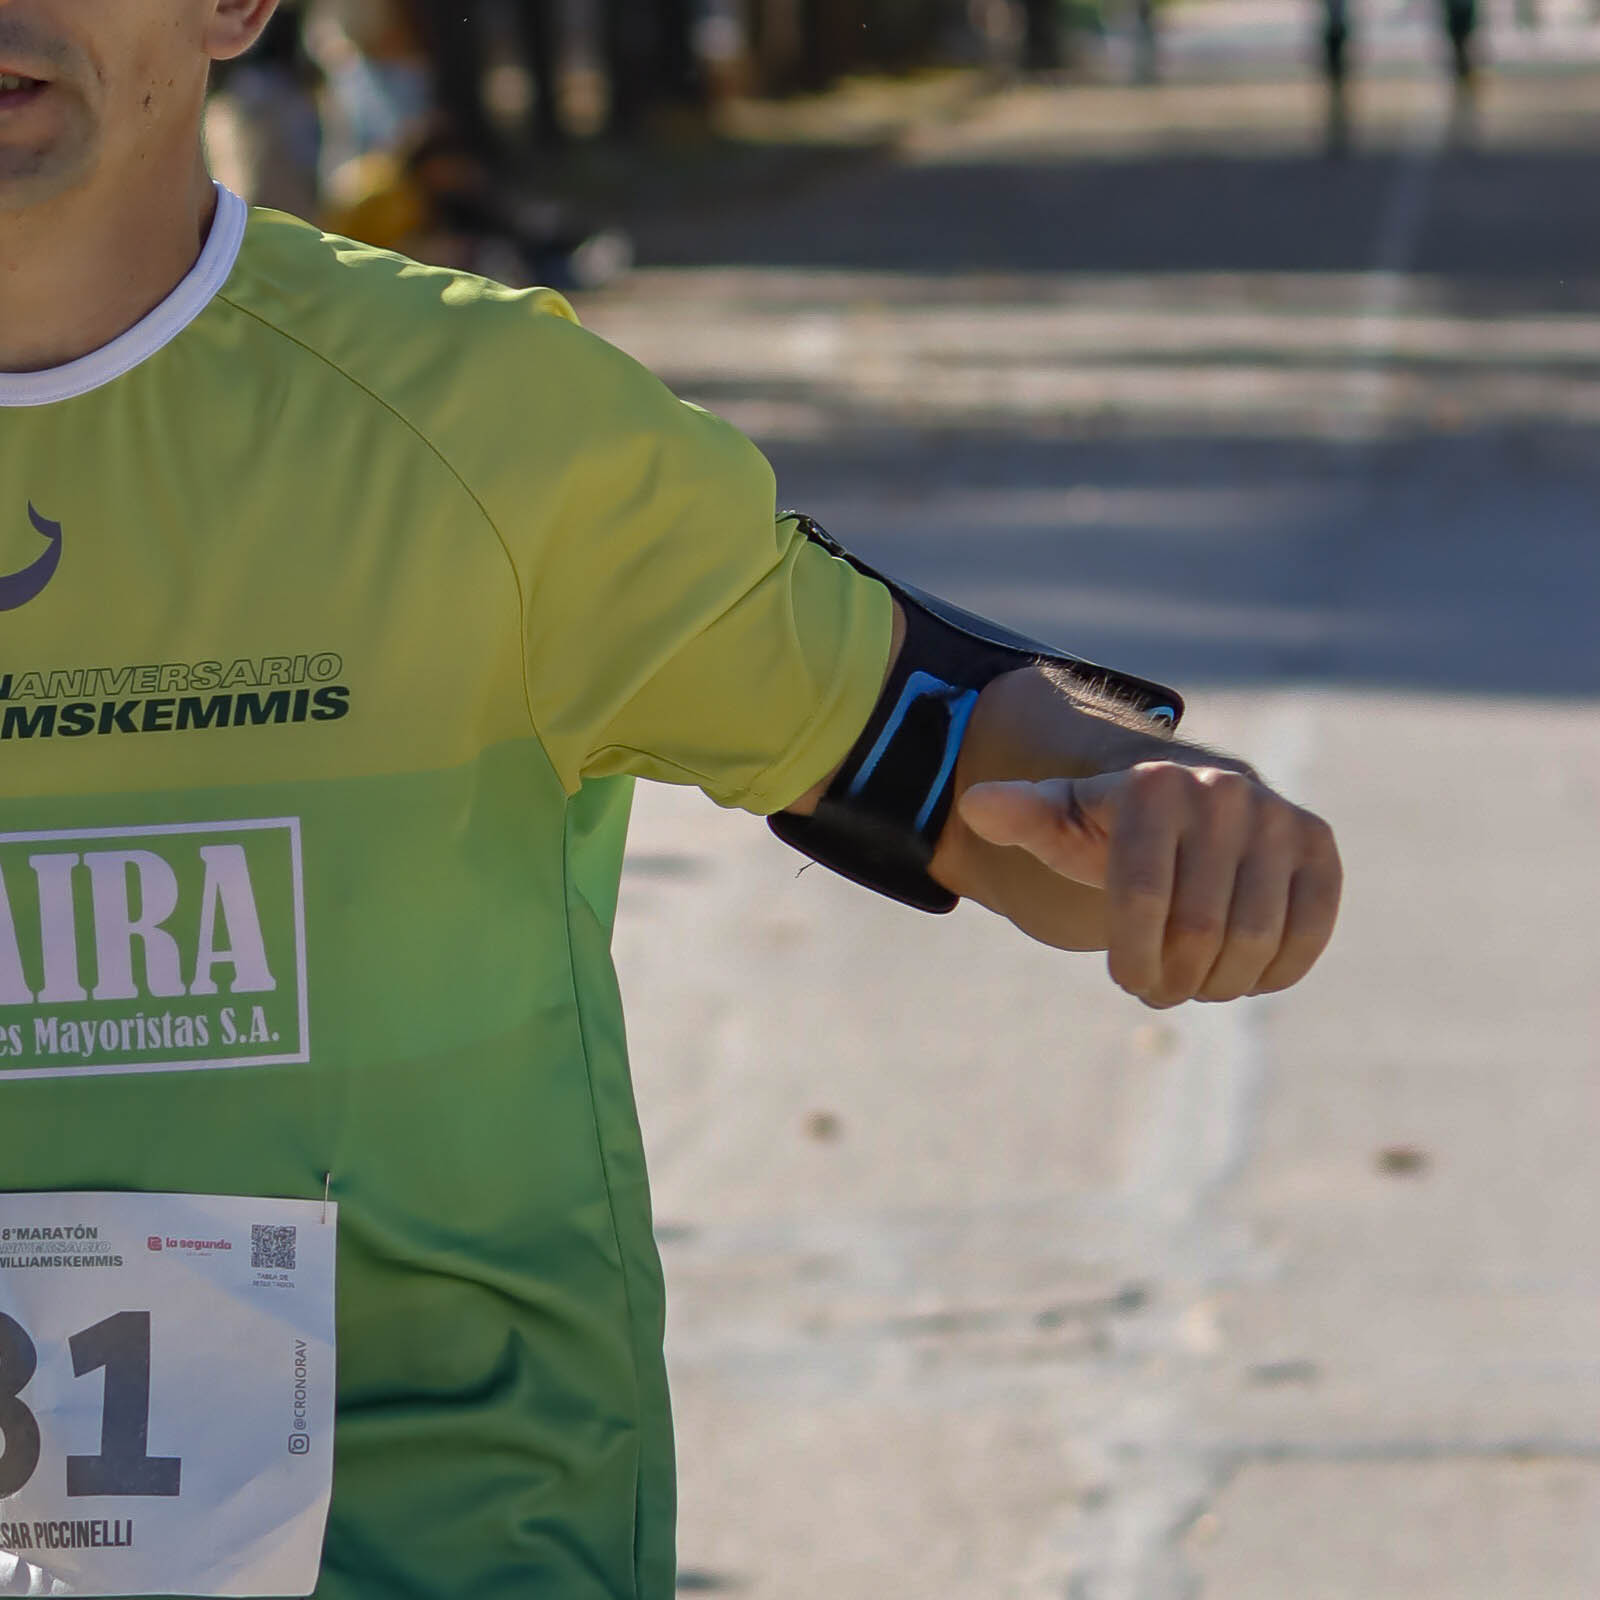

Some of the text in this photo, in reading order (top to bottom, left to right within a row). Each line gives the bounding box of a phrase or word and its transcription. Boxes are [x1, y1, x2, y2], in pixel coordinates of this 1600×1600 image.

[34, 1011, 209, 1058] Mayoristas
[220, 1005, 280, 1045] S.A.
[166, 1237, 232, 1251] la segunda
[293, 1339, 308, 1431] @CRONORAV
[33, 1519, 133, 1549] PICCINELLI
